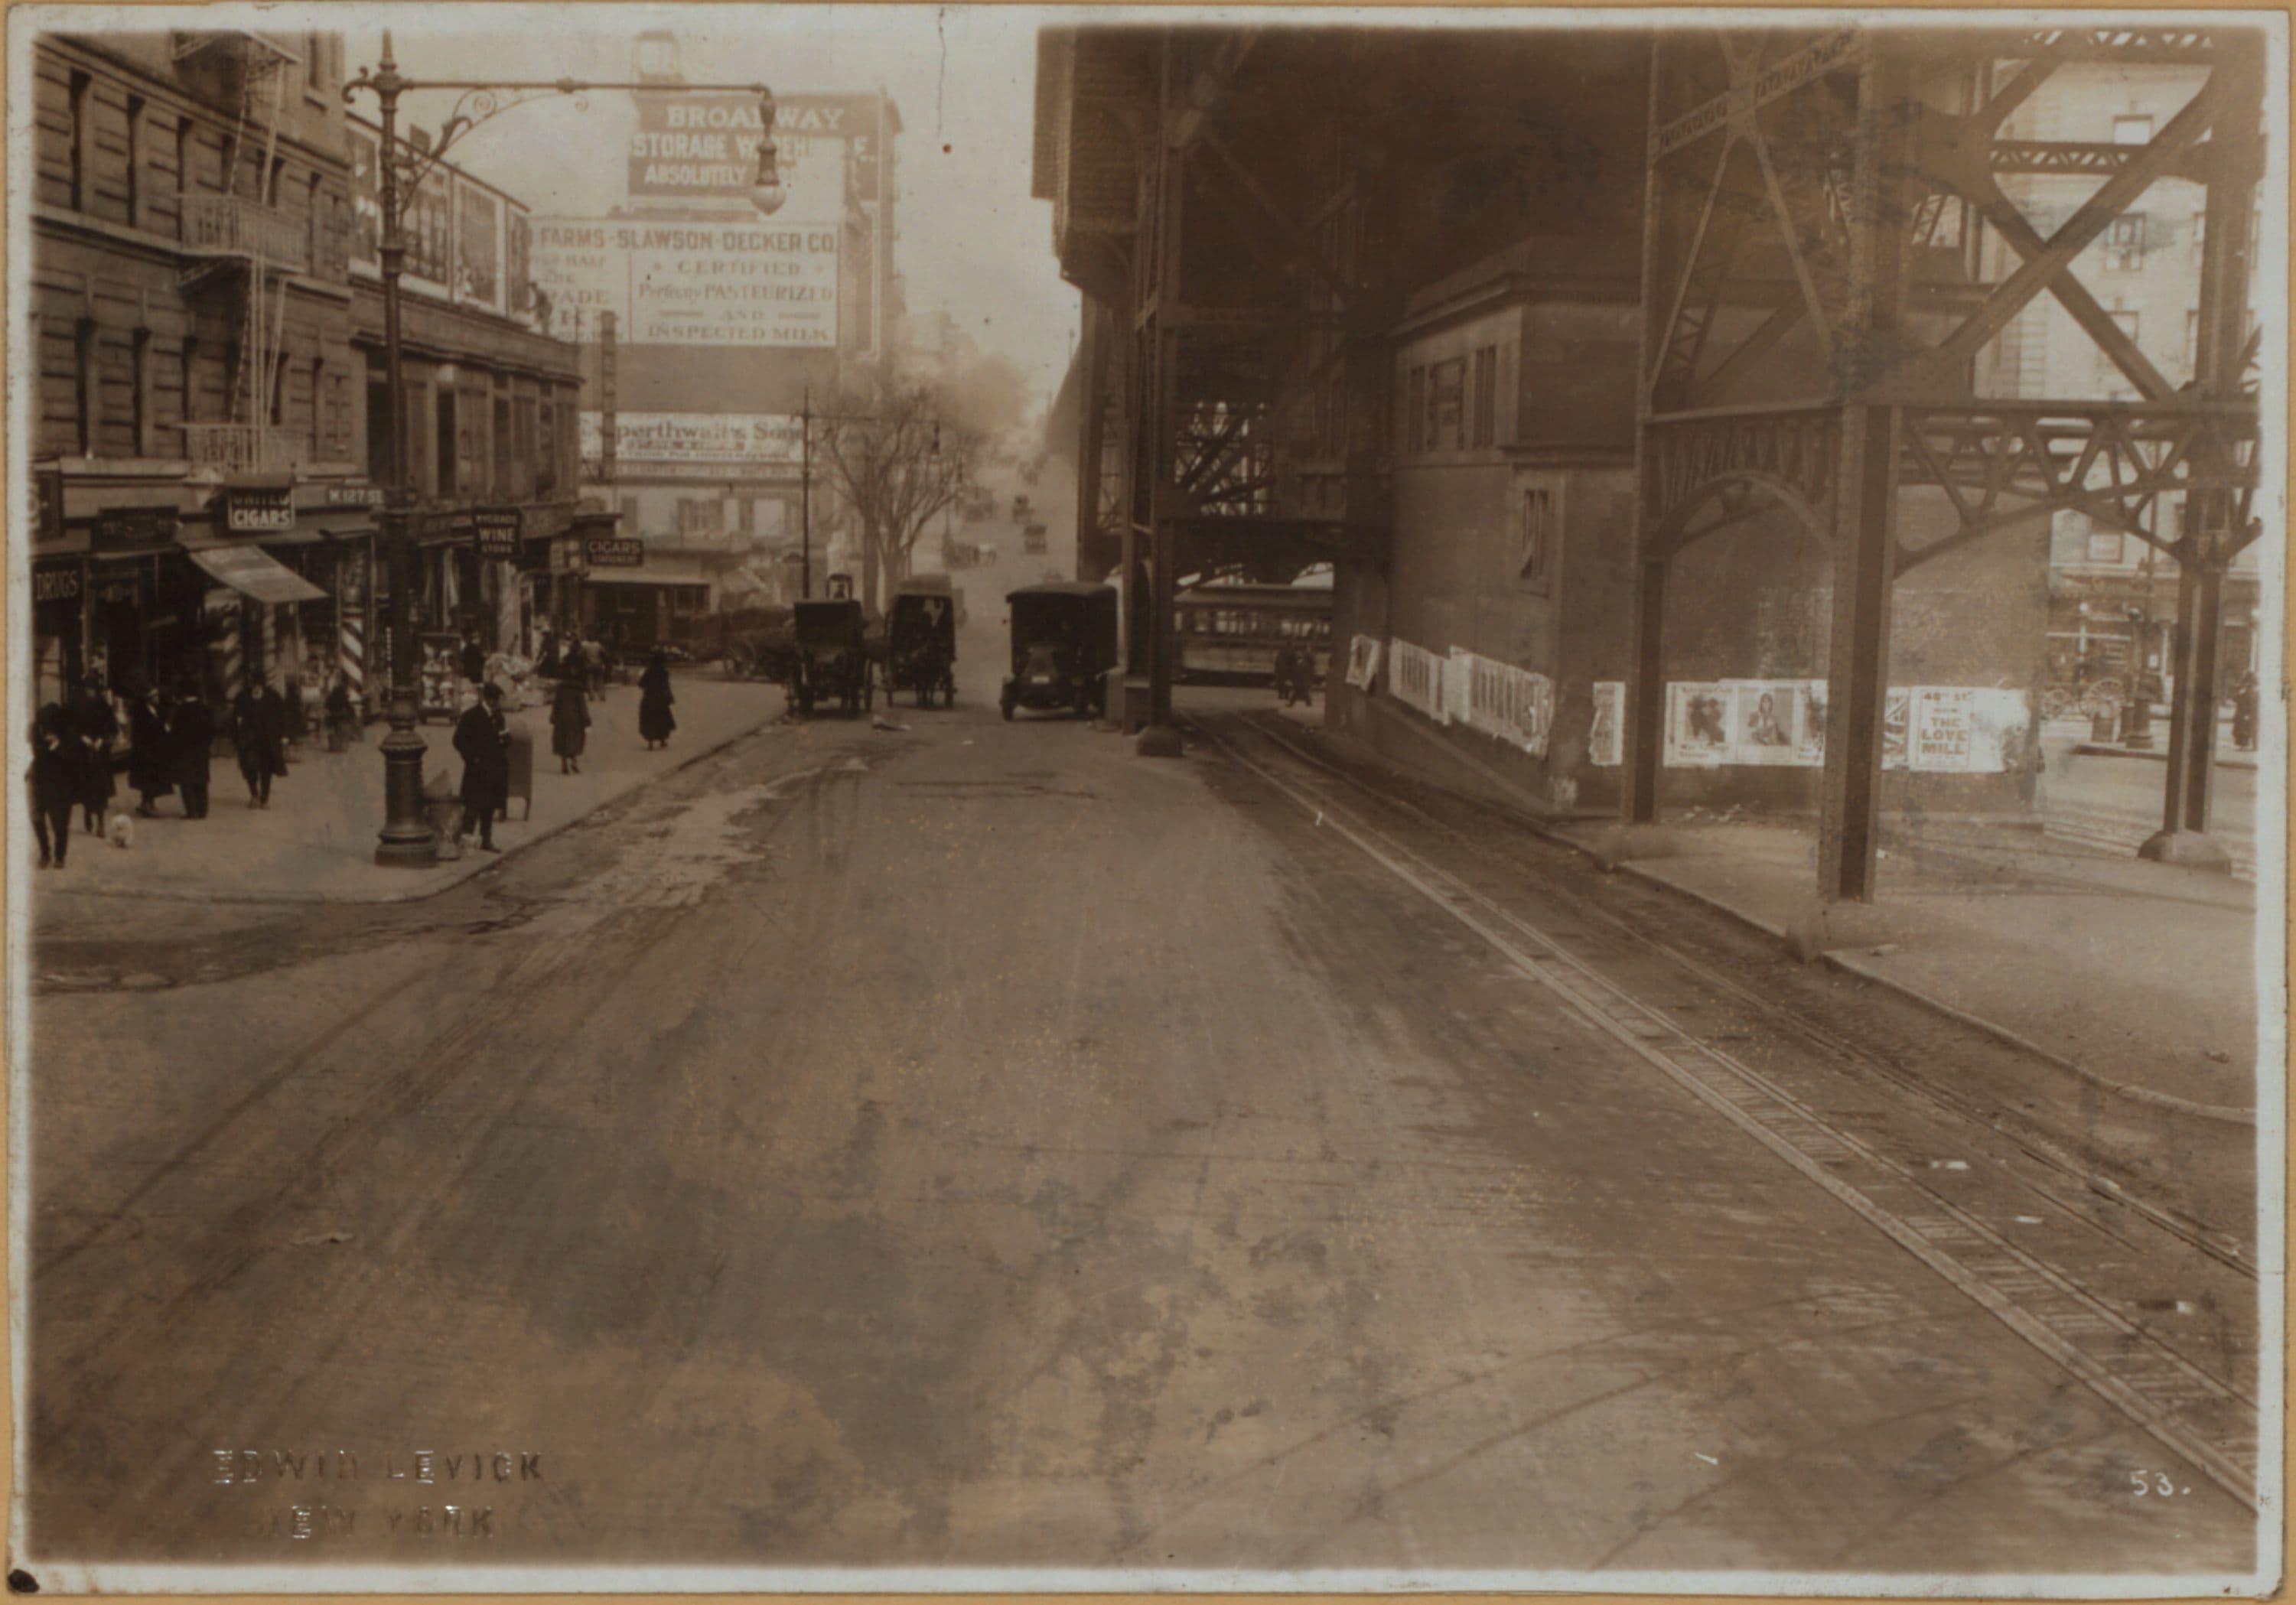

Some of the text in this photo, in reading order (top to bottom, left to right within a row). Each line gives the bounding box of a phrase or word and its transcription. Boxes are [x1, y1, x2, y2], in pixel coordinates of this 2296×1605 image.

[632, 133, 728, 160] STORAGE
[643, 161, 747, 187] ABSOLUTELY
[540, 227, 604, 249] FARMS
[617, 228, 713, 251] SLAWSON
[722, 230, 802, 252] DECKER
[677, 259, 801, 276] CERTIFIED
[704, 283, 835, 301] PASTEURIZED
[647, 324, 767, 340] INSPECTED
[234, 509, 289, 527] CIGARS
[478, 526, 515, 542] WINE
[588, 540, 640, 554] CIGARS
[35, 569, 79, 601] DRUGS
[1930, 717, 1962, 728] THE
[1921, 728, 1968, 741] LOVE
[1921, 742, 1965, 755] MILL
